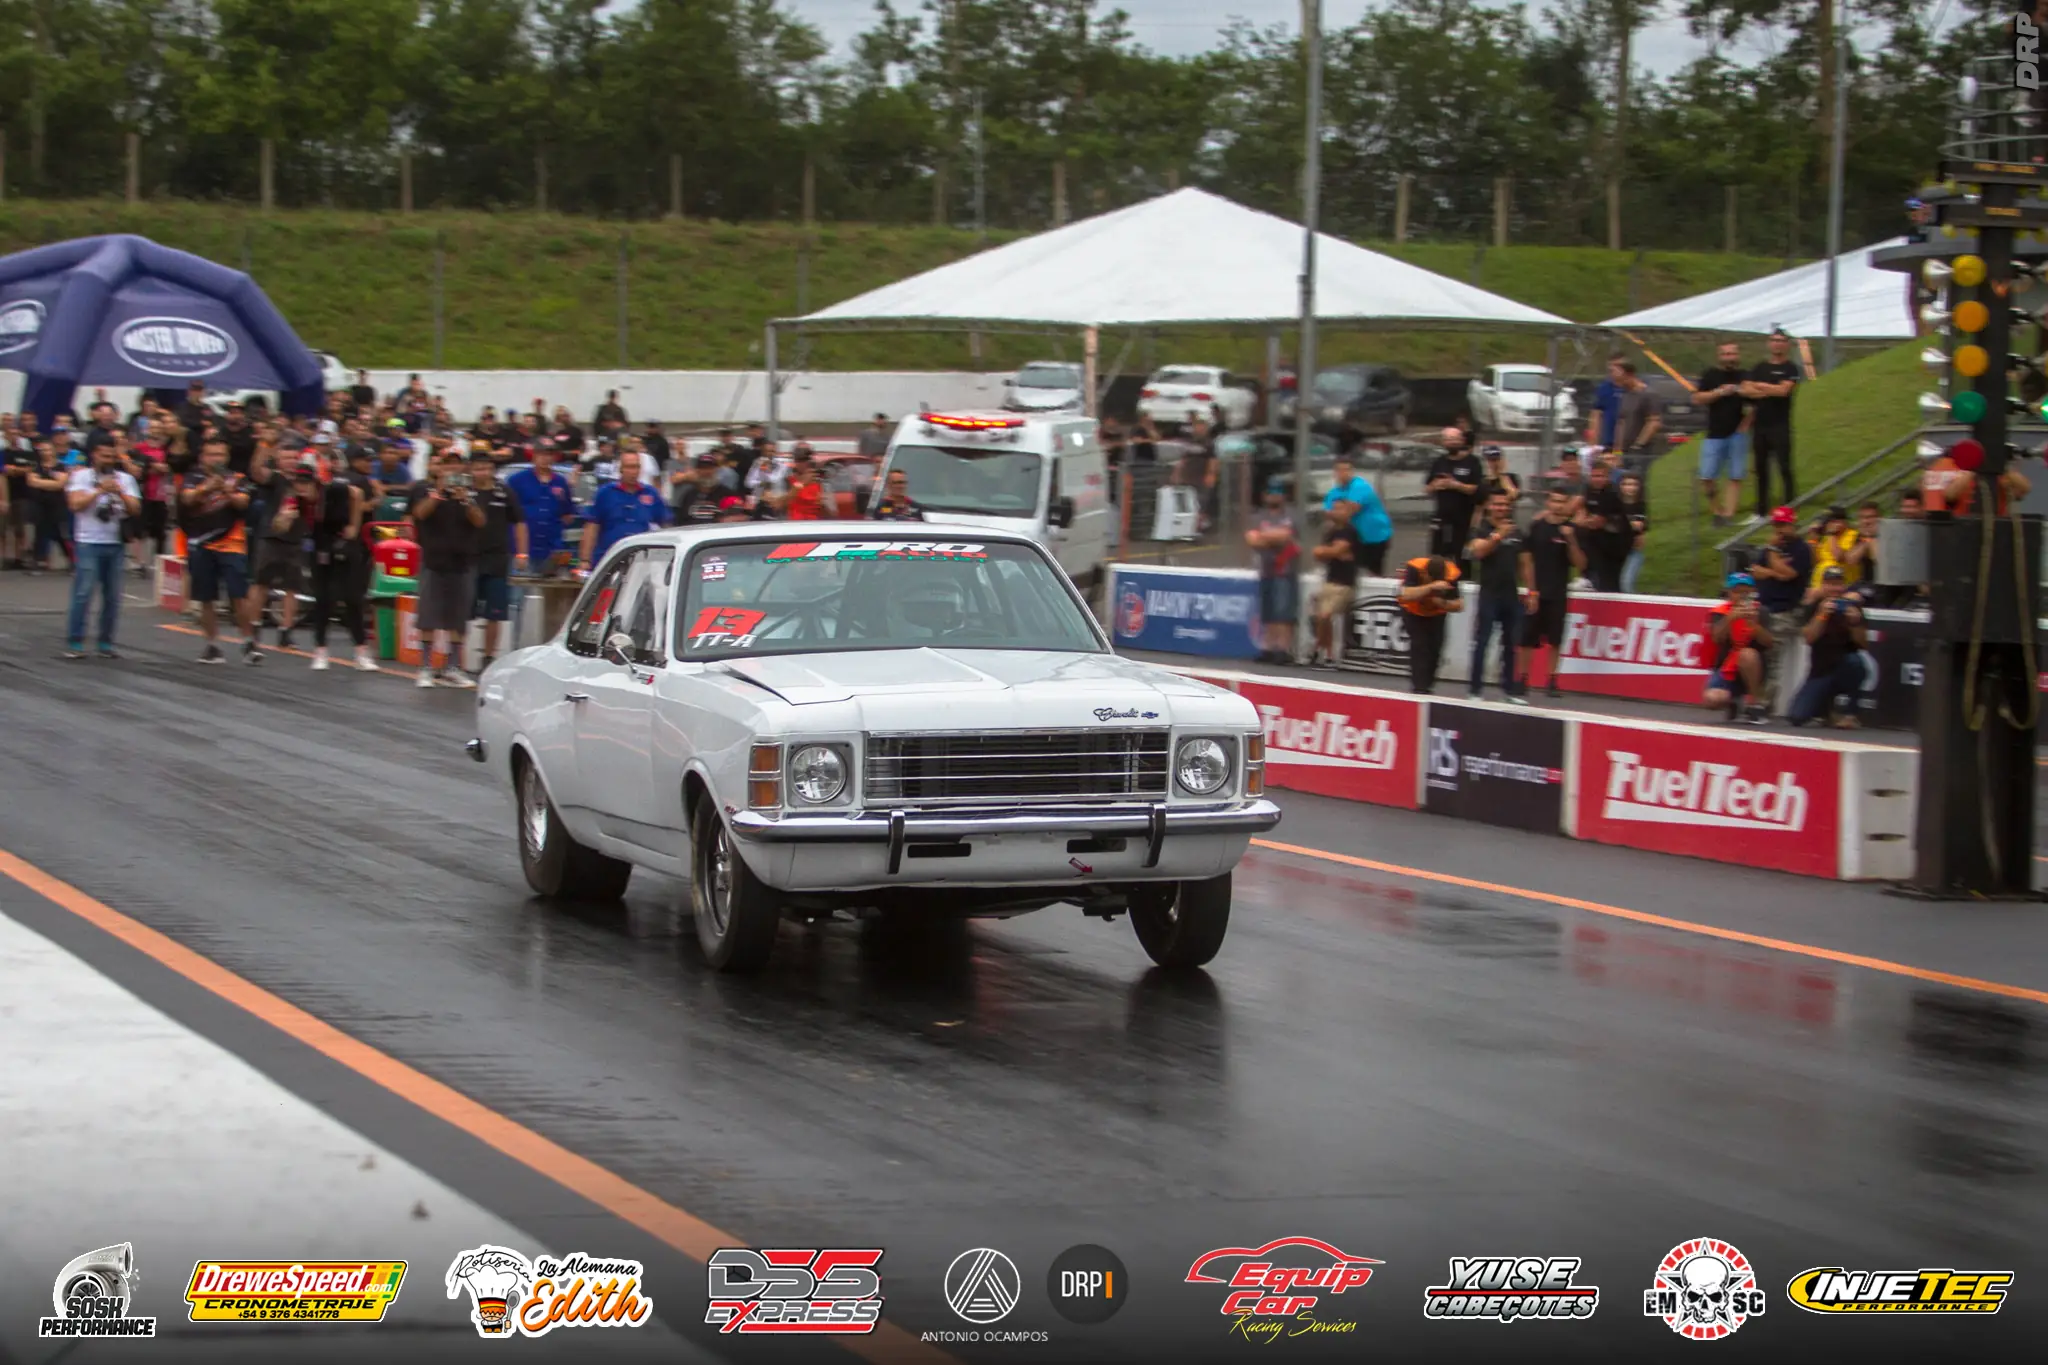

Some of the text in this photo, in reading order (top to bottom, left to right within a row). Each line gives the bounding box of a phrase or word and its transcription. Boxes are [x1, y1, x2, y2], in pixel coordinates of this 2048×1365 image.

[688, 606, 767, 639] 13
[692, 632, 757, 649] TT-A
[1562, 612, 1704, 667] FuelTec
[1257, 704, 1399, 769] FuelTech
[1605, 750, 1809, 831] FuelTech
